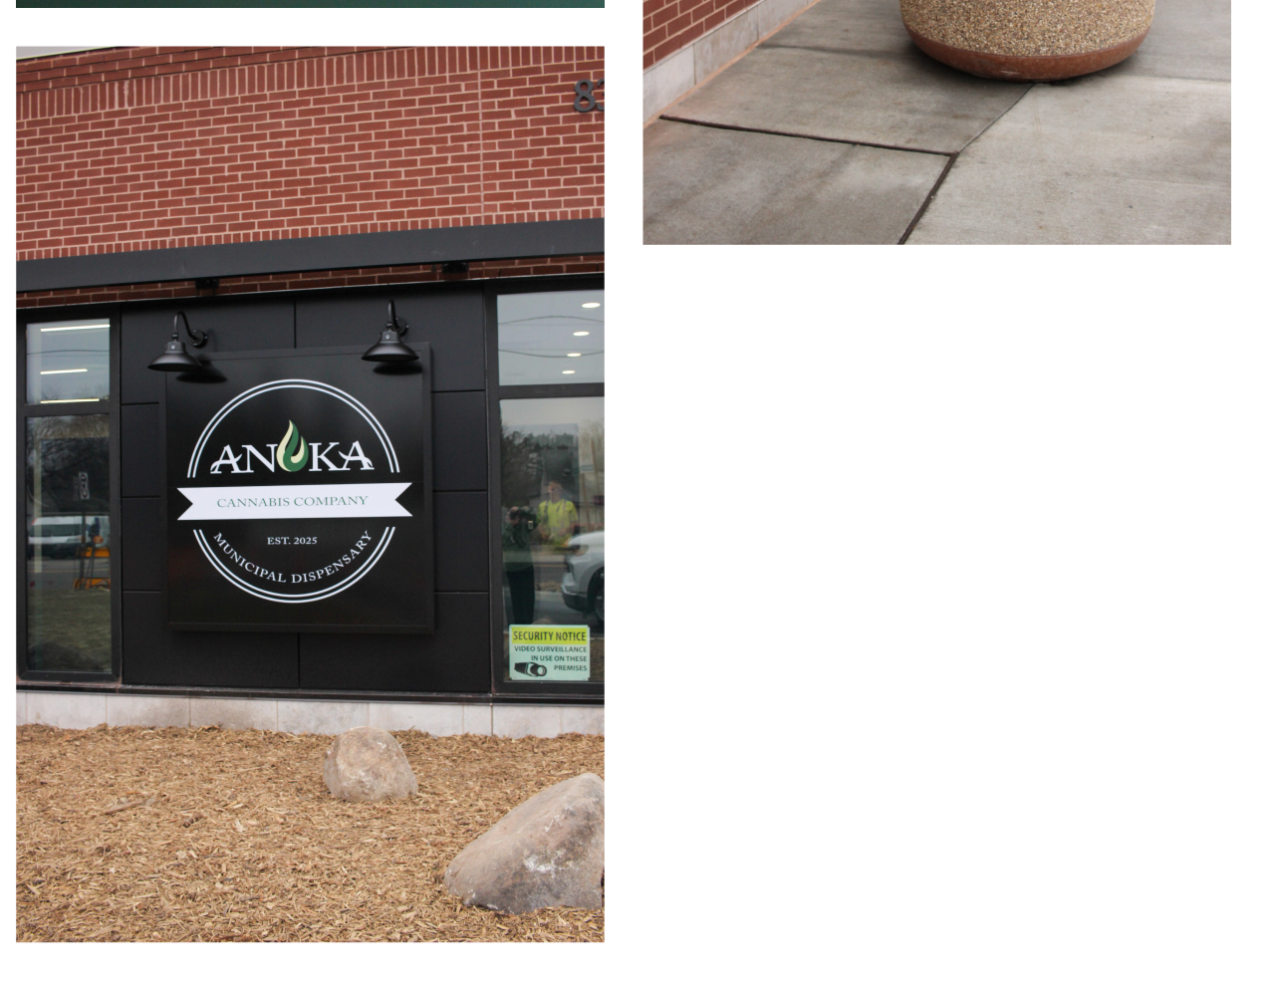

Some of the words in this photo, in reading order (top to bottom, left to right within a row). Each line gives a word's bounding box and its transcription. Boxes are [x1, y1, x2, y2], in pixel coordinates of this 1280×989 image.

[216, 496, 290, 508] CANNABIS
[293, 495, 369, 507] COMPANY
[267, 536, 291, 545] EST.
[293, 536, 318, 545] 2025
[213, 532, 286, 583] MUNICIPAL
[291, 530, 372, 583] DISPENSARY
[513, 630, 554, 641] SECURITY
[555, 631, 586, 642] NOTICE
[536, 645, 587, 653] SURVEILLANCE
